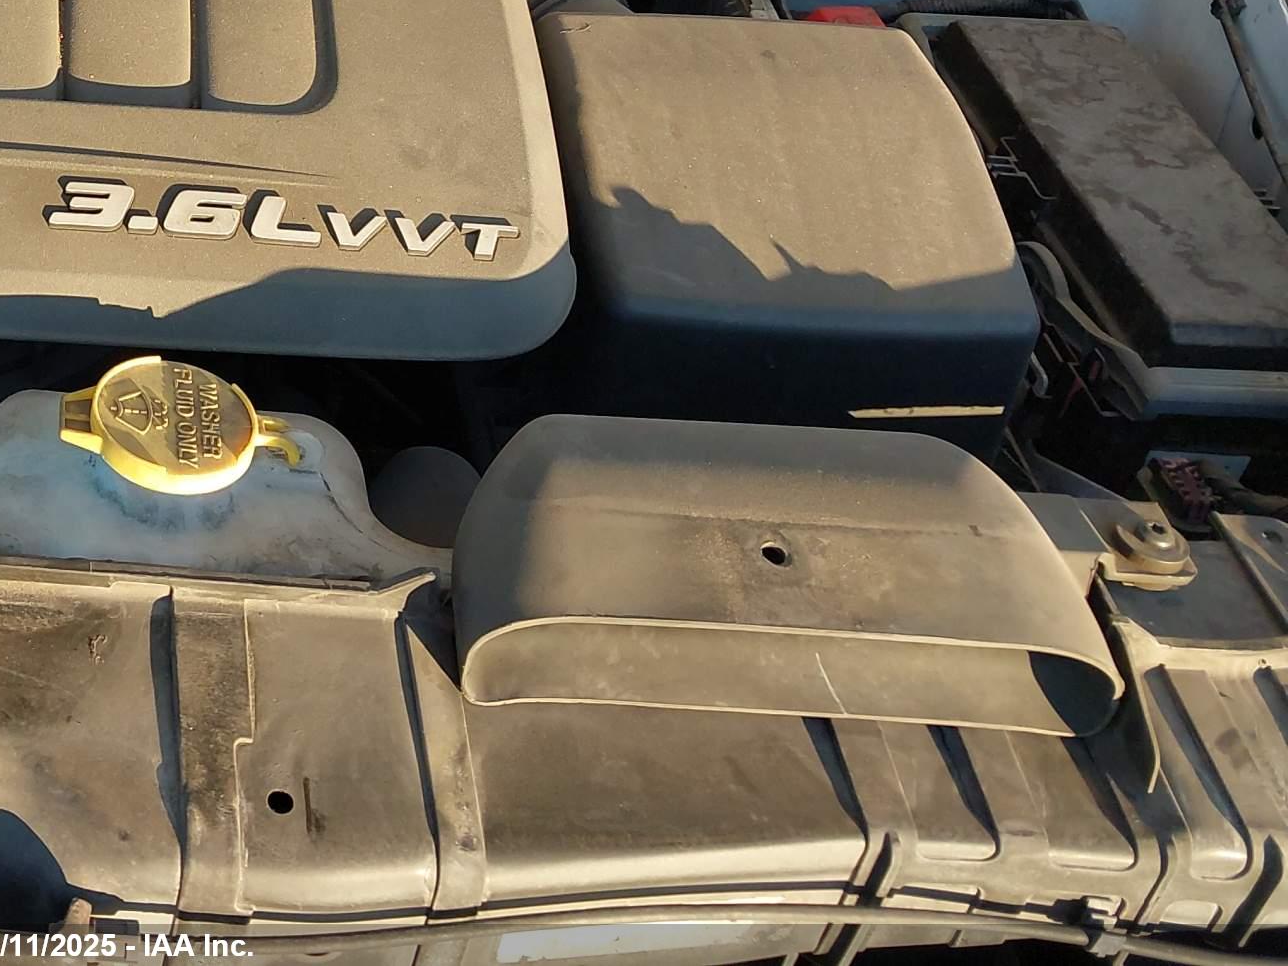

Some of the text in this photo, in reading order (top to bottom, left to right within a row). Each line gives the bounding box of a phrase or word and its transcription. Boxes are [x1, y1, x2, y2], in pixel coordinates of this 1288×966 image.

[173, 368, 200, 469] FLUID ONLY
[199, 383, 223, 460] WASHER
